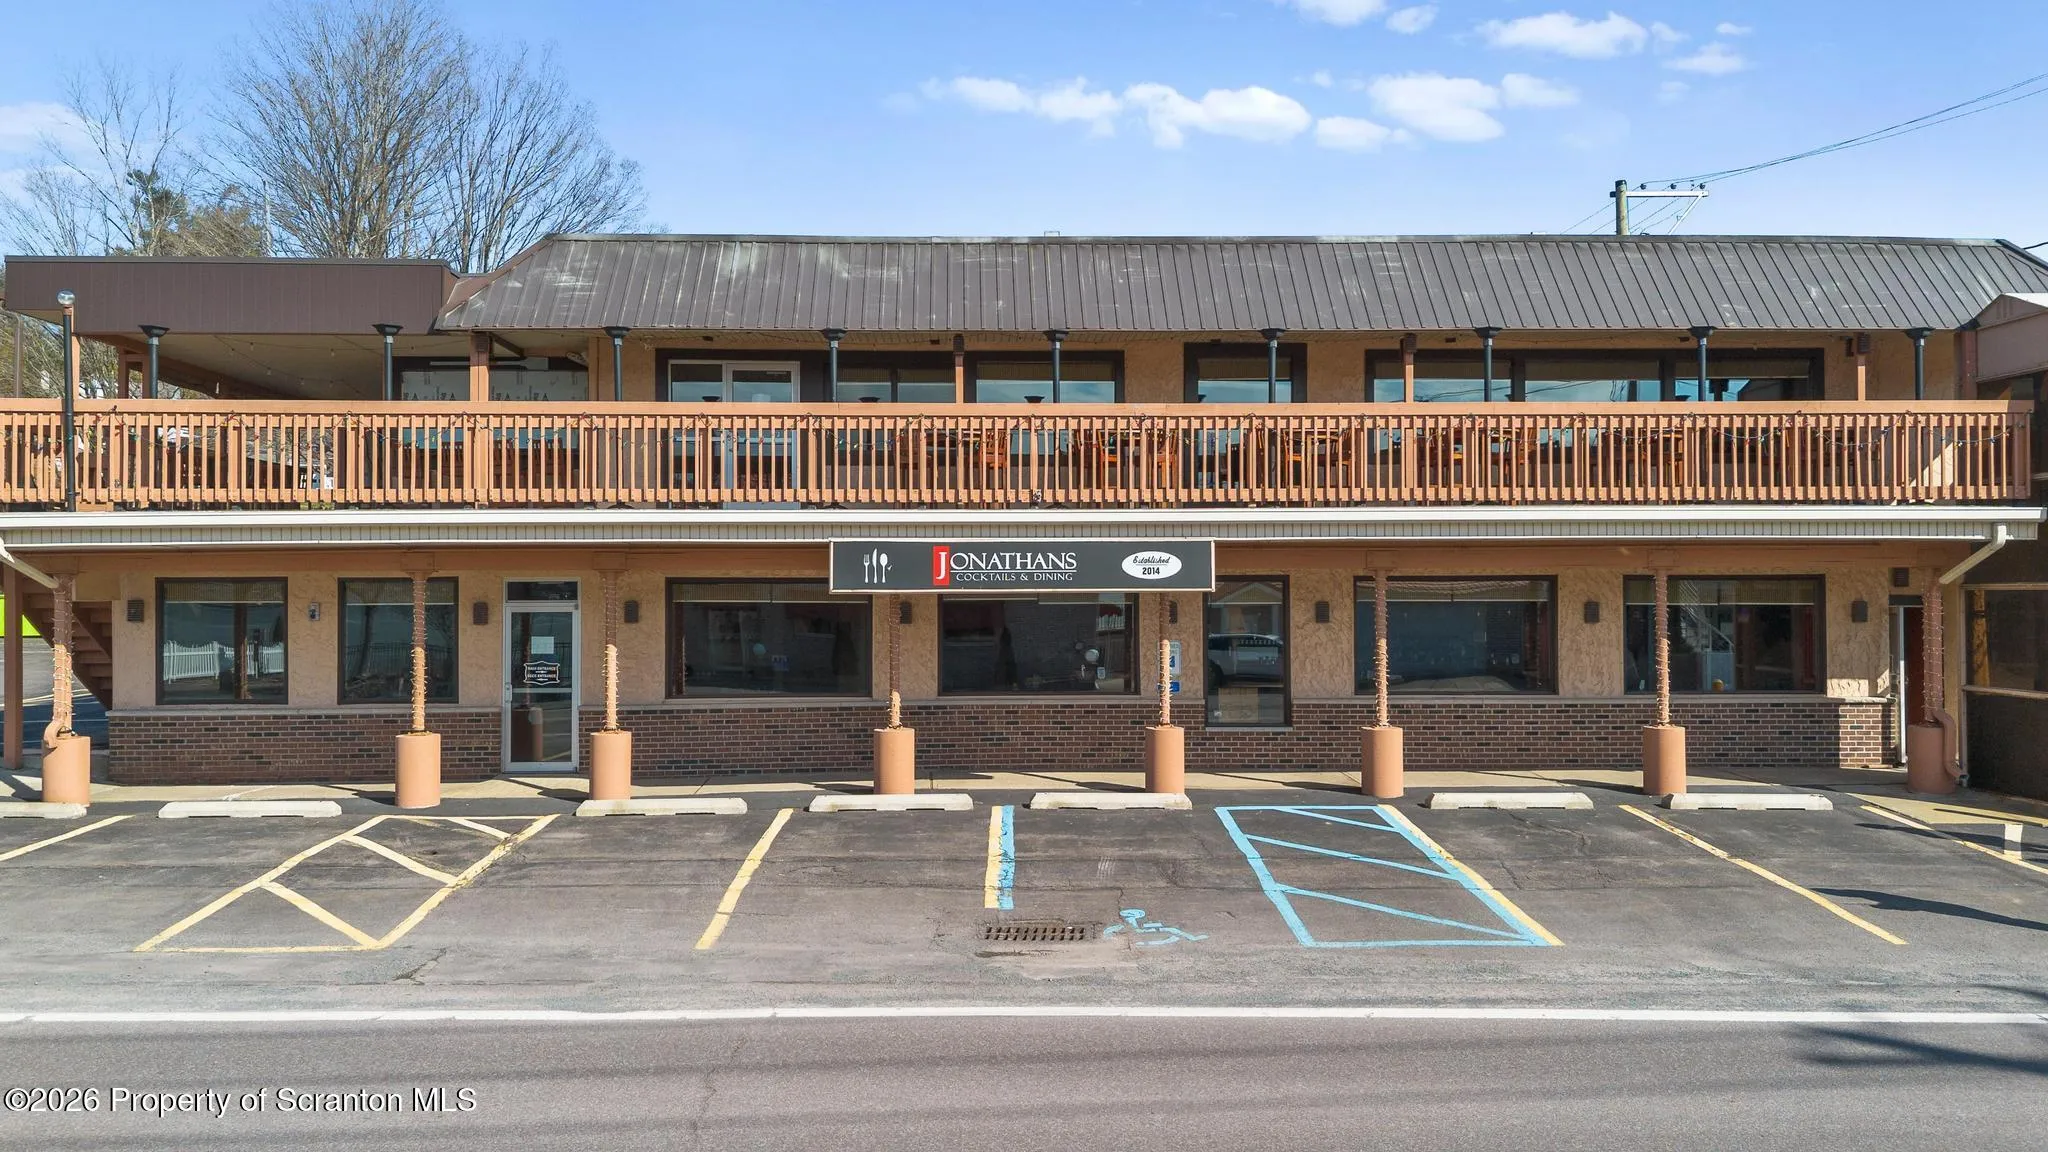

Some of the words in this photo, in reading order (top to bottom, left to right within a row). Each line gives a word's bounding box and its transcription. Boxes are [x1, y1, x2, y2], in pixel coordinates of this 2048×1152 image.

[1133, 555, 1171, 564] Established
[936, 551, 1077, 580] JONATHANS
[1142, 567, 1160, 575] 2014
[956, 573, 1016, 581] COCKTAILS
[1020, 573, 1028, 581] &
[1034, 573, 1073, 581] DINING
